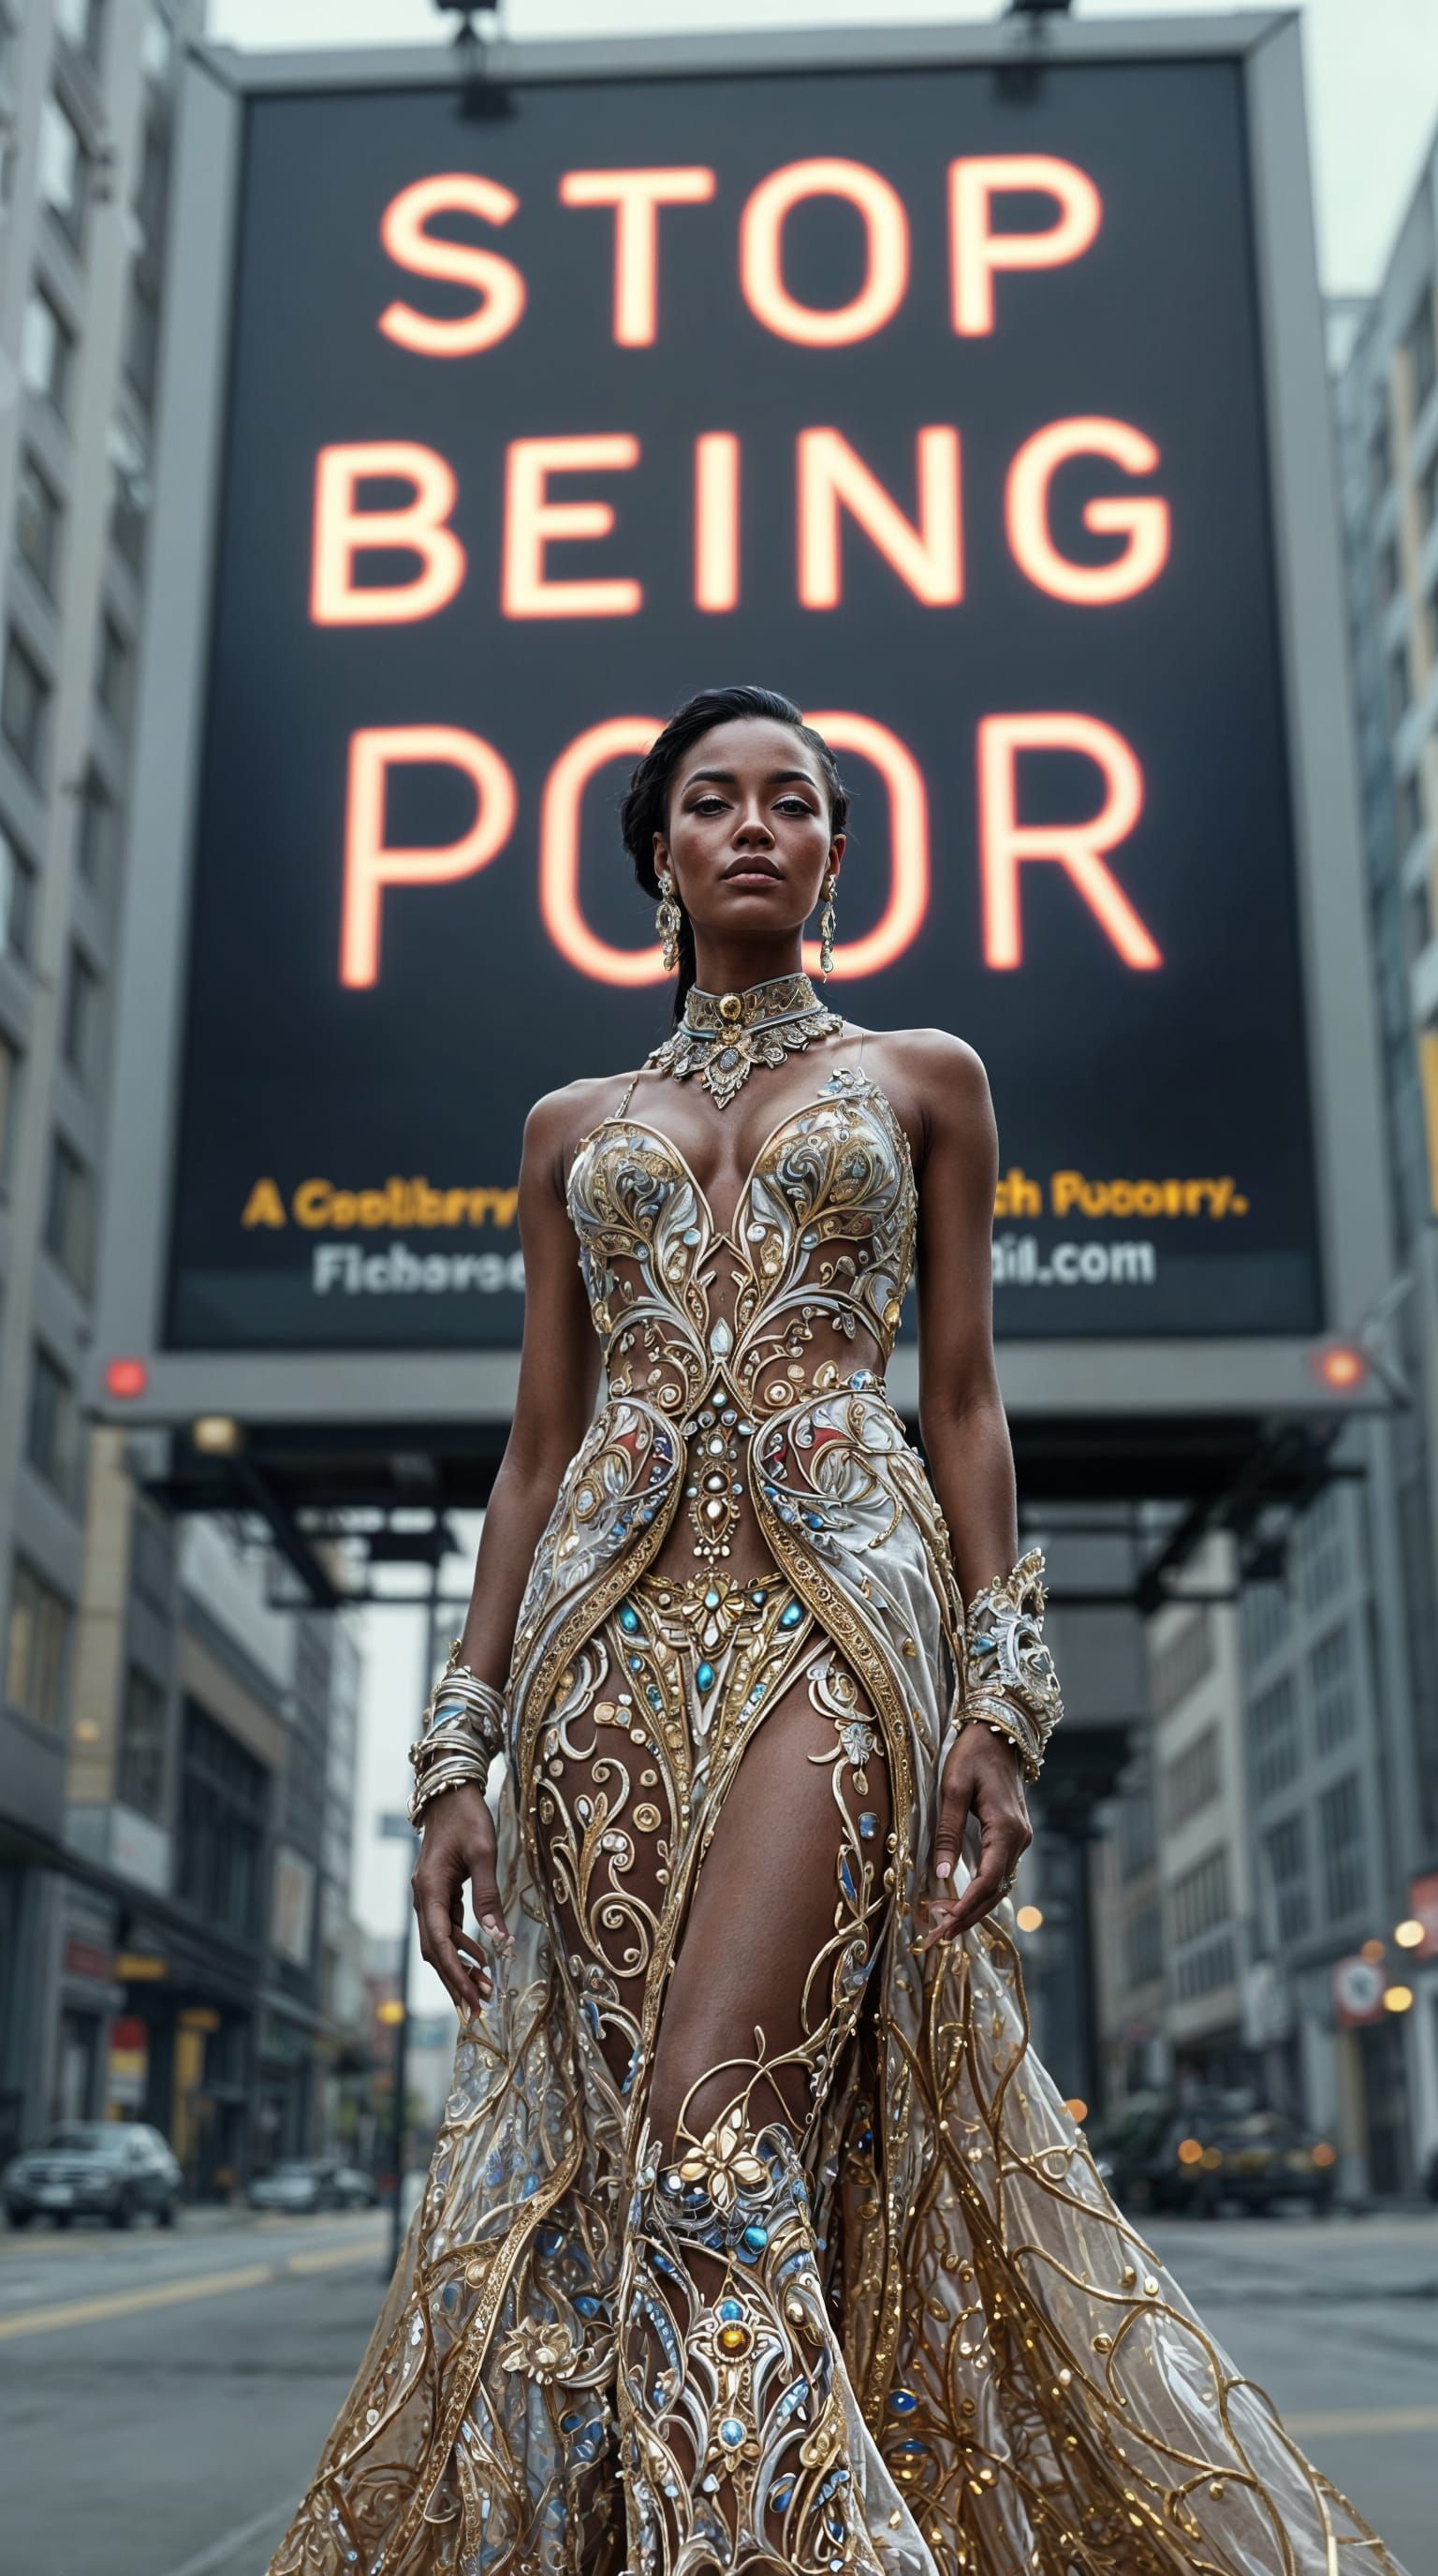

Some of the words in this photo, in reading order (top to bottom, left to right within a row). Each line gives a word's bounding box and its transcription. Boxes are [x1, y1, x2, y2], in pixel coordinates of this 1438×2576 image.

[376, 152, 1105, 359] STOP
[308, 414, 1173, 628] BEING
[243, 1178, 286, 1227] A
